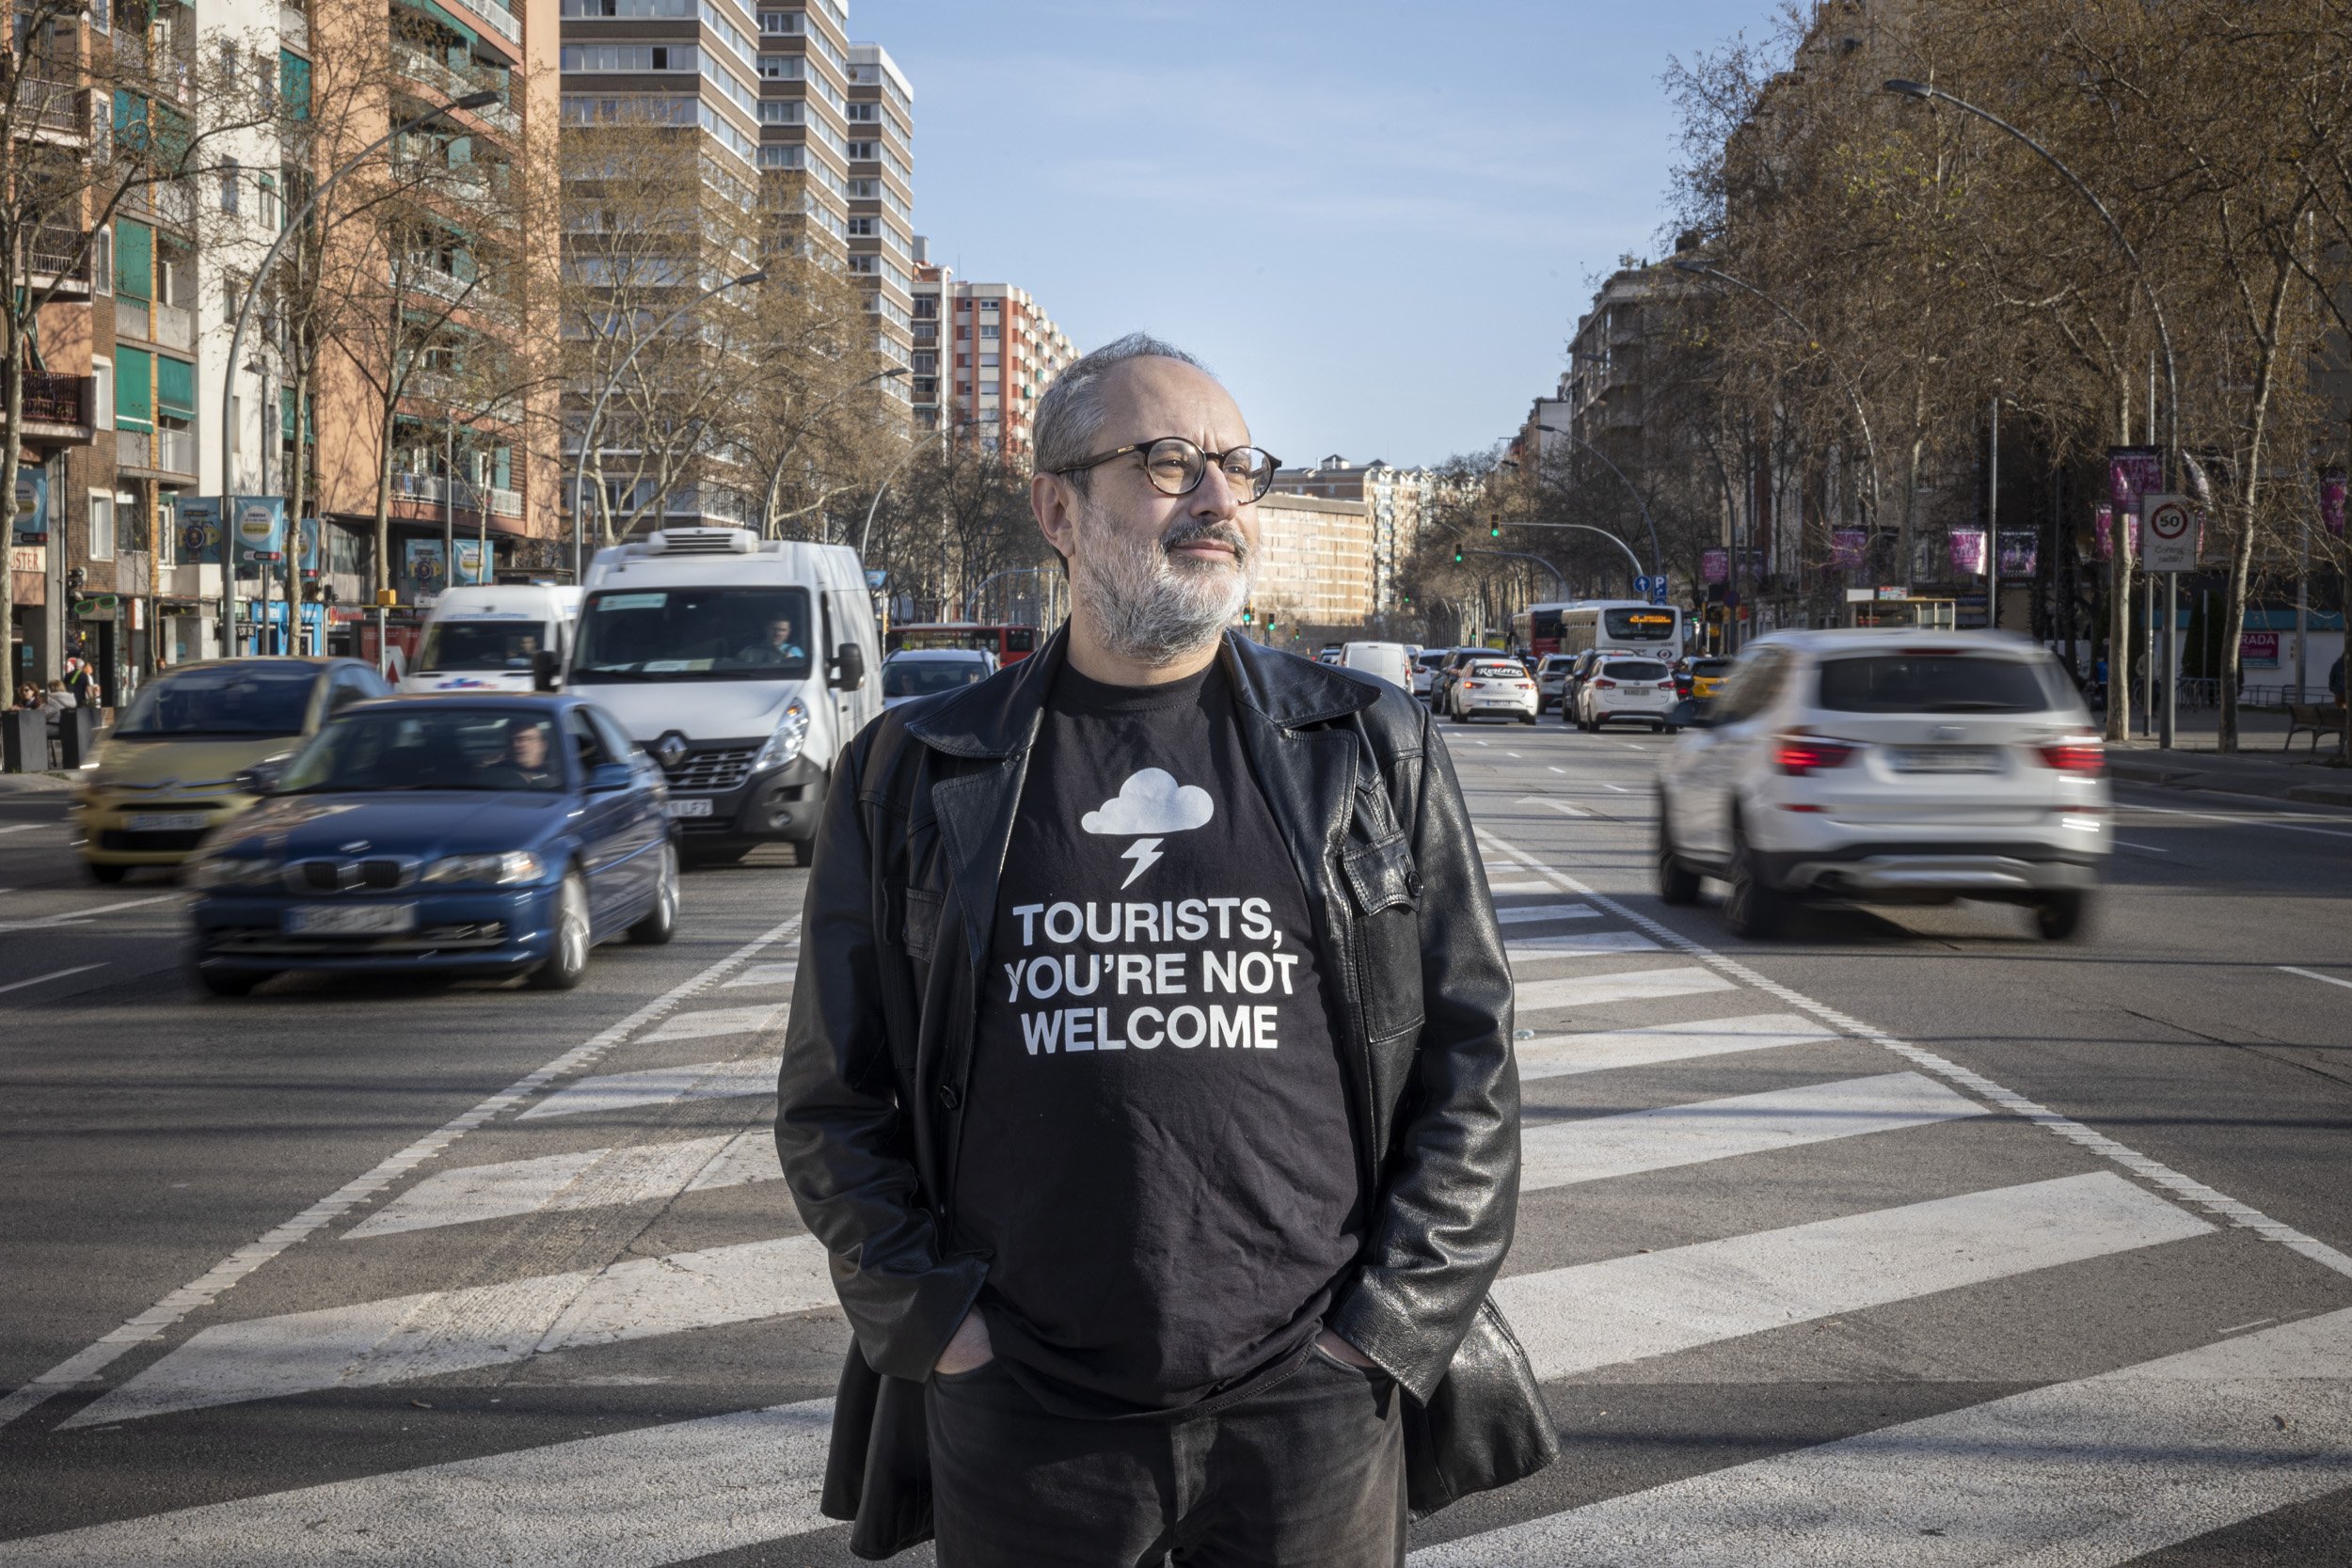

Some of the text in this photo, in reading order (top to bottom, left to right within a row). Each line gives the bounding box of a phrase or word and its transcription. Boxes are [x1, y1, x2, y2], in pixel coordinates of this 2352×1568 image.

[2160, 515, 2180, 527] 50
[1656, 577, 1664, 588] P
[2240, 634, 2275, 645] RADA
[1012, 897, 1282, 949] TOURISTS,
[1004, 950, 1298, 1003] YOU'RE NOT
[1021, 1005, 1279, 1055] WELCOME
